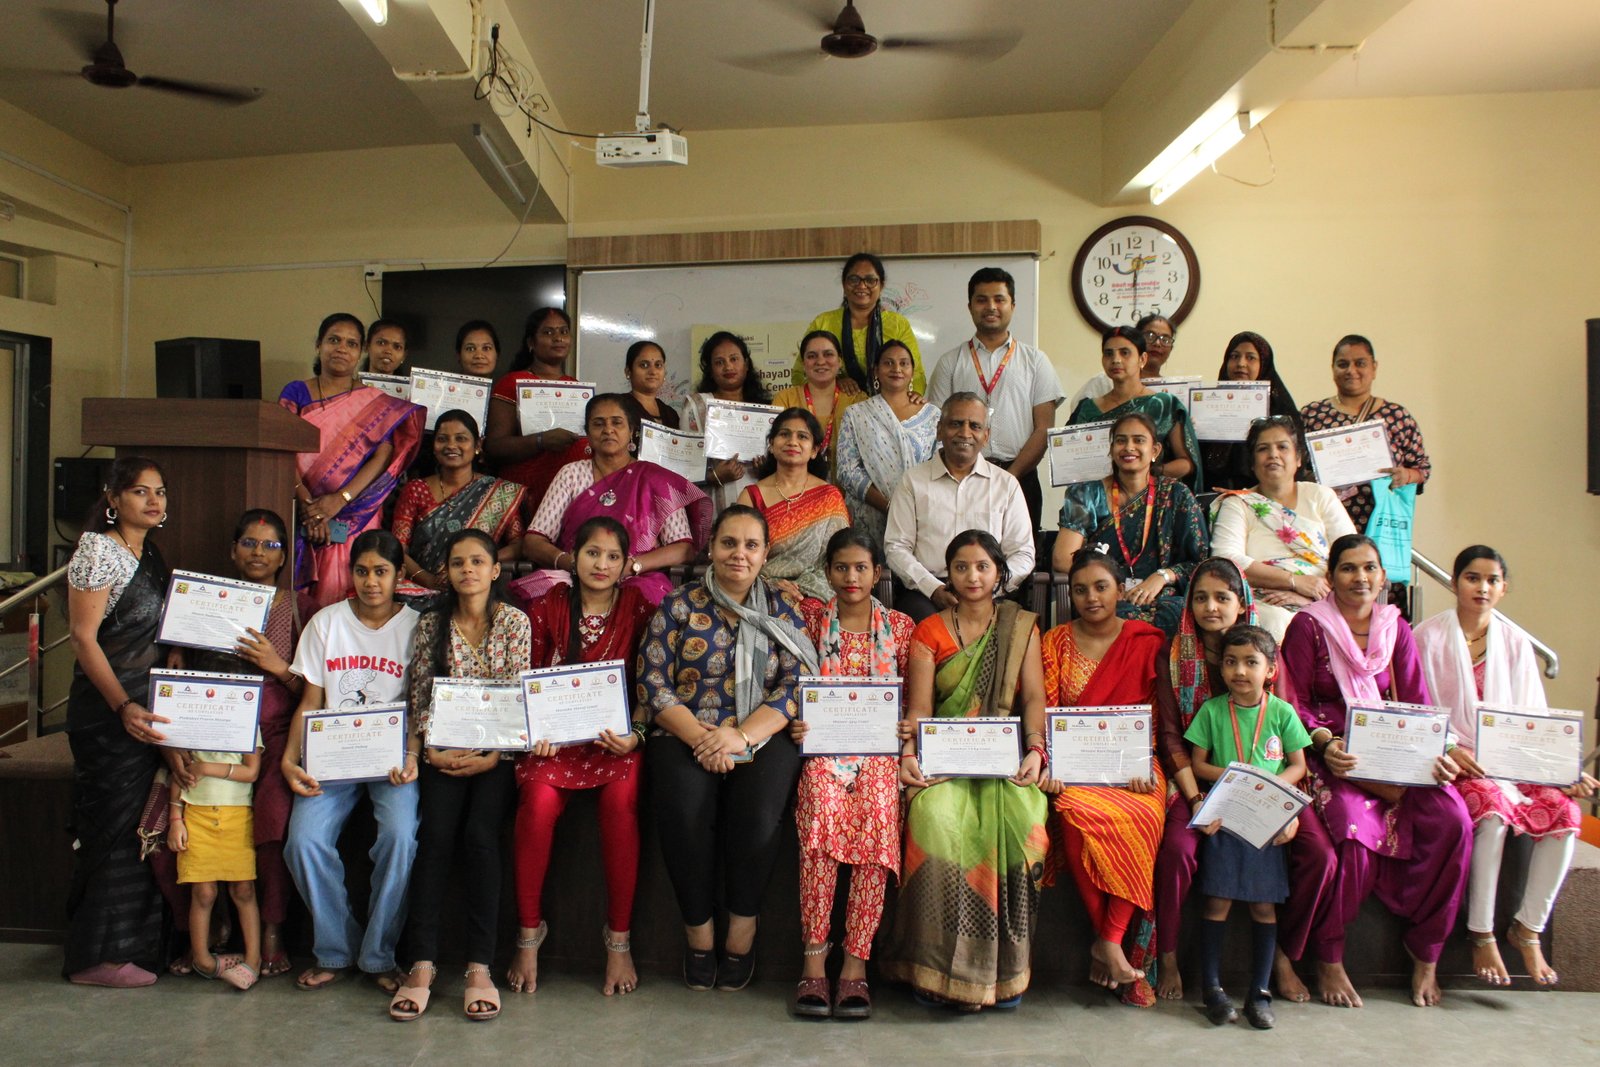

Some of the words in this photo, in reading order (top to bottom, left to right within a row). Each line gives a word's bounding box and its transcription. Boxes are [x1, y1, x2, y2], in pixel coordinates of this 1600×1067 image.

[1110, 242, 1121, 256] 11
[1127, 236, 1142, 249] 12
[1150, 240, 1155, 252] 1
[1098, 256, 1112, 270] 10
[1162, 252, 1172, 264] 2
[1094, 274, 1105, 288] 9
[1168, 270, 1178, 283] 3
[1099, 292, 1109, 306] 8
[1162, 288, 1172, 302] 4
[1112, 306, 1123, 319] 7
[1130, 309, 1142, 322] 6
[1150, 303, 1161, 316] 5
[758, 369, 793, 381] hayaD
[766, 383, 792, 392] Centr
[326, 656, 404, 678] MINDLESS
[176, 702, 236, 711] CERTIFICATE
